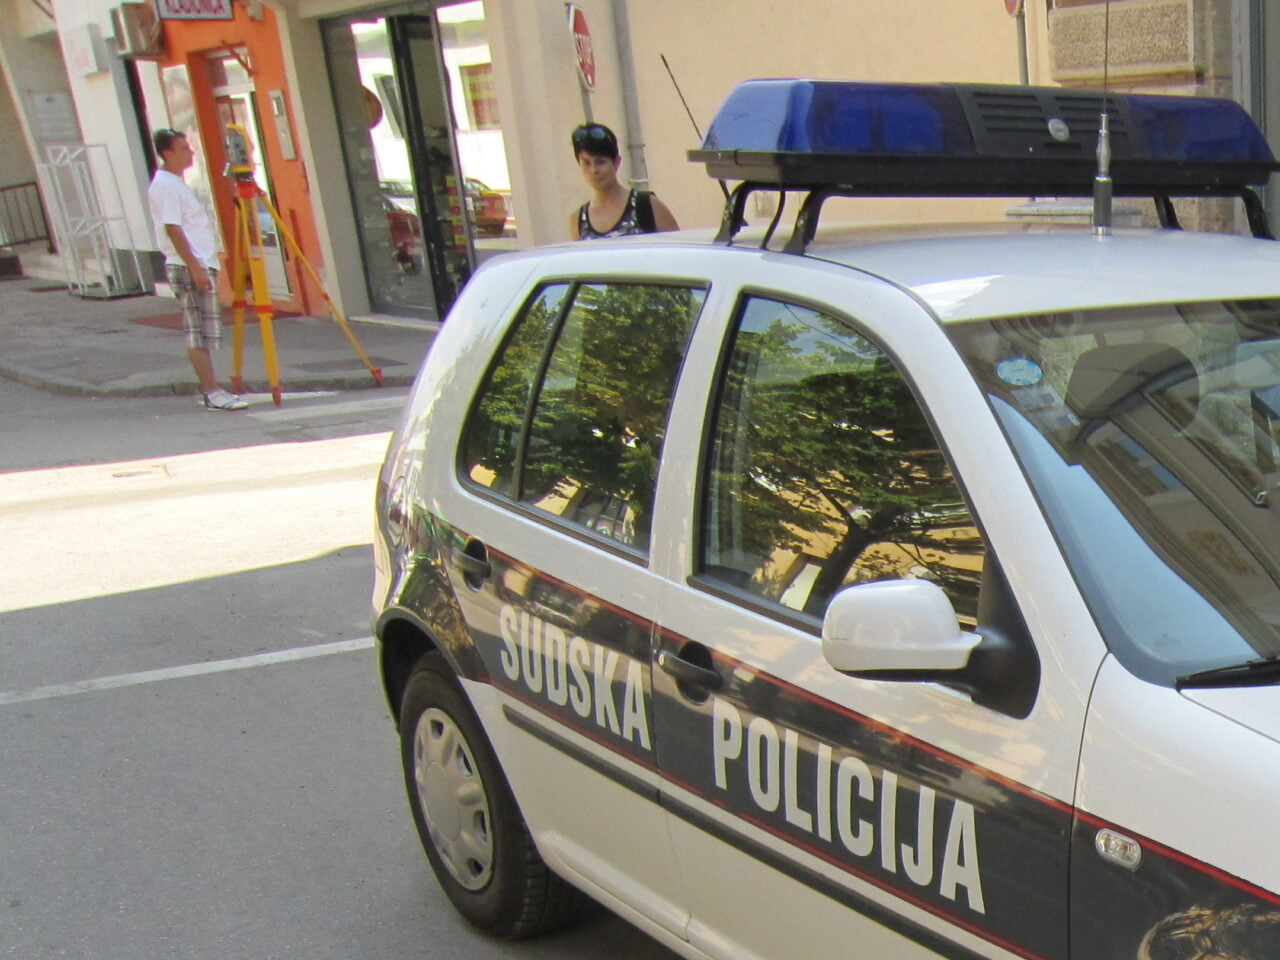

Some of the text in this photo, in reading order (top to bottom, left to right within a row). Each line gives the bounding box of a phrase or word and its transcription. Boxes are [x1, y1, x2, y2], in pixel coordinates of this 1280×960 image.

[574, 32, 595, 65] STOP
[500, 604, 986, 915] SUDSKA POLICIJA
